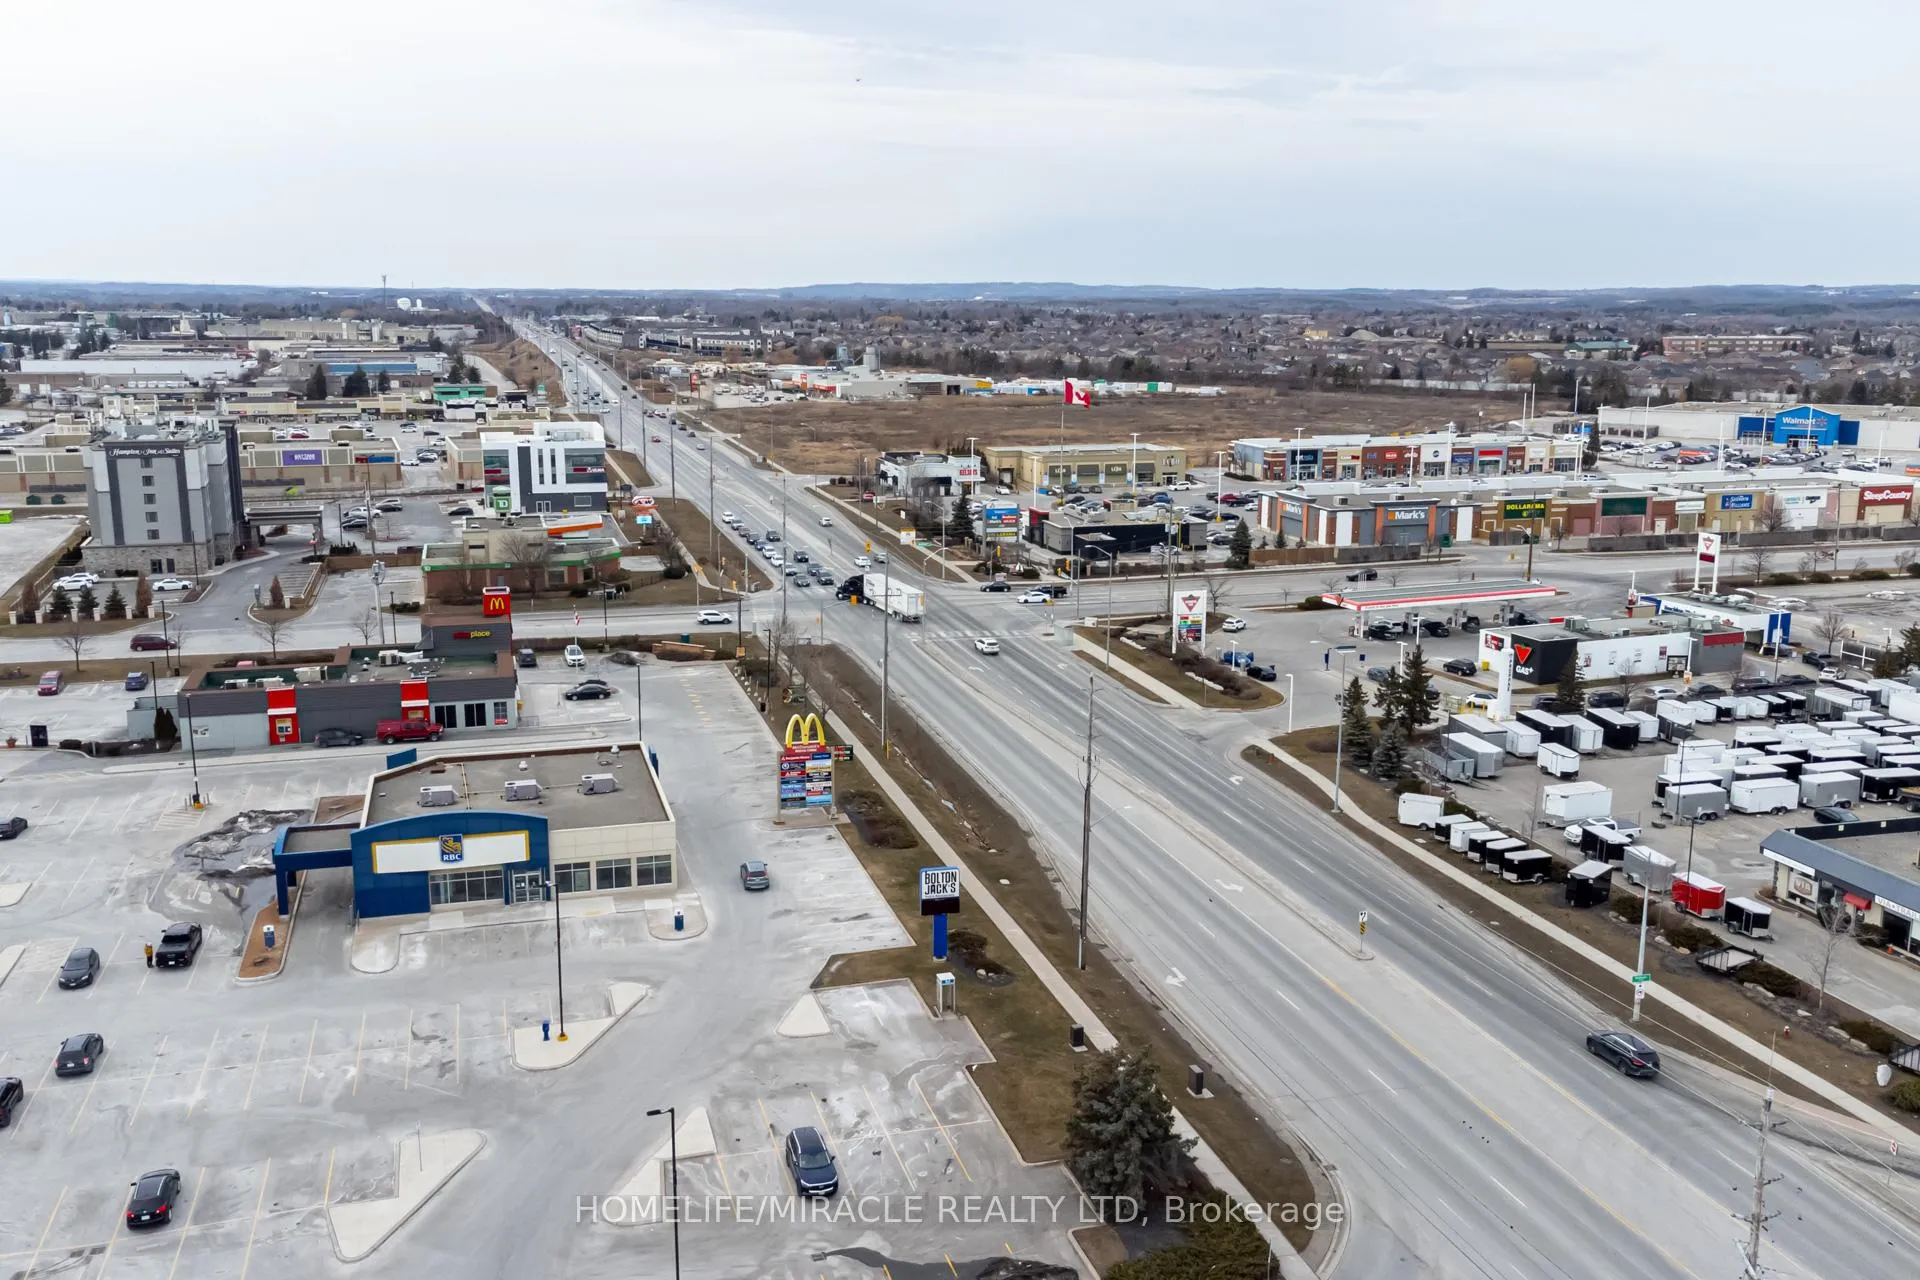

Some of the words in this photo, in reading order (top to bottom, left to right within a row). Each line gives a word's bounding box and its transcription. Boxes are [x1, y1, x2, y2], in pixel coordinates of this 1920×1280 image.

[1782, 416, 1816, 425] Walmart
[109, 448, 141, 456] Hampton
[499, 500, 509, 508] TD
[1506, 503, 1545, 511] DOLLARAMA
[1395, 510, 1425, 520] Mark's
[470, 630, 490, 639] place
[443, 853, 462, 861] RBC
[924, 871, 957, 885] BOLTON
[924, 882, 956, 895] JACK'S
